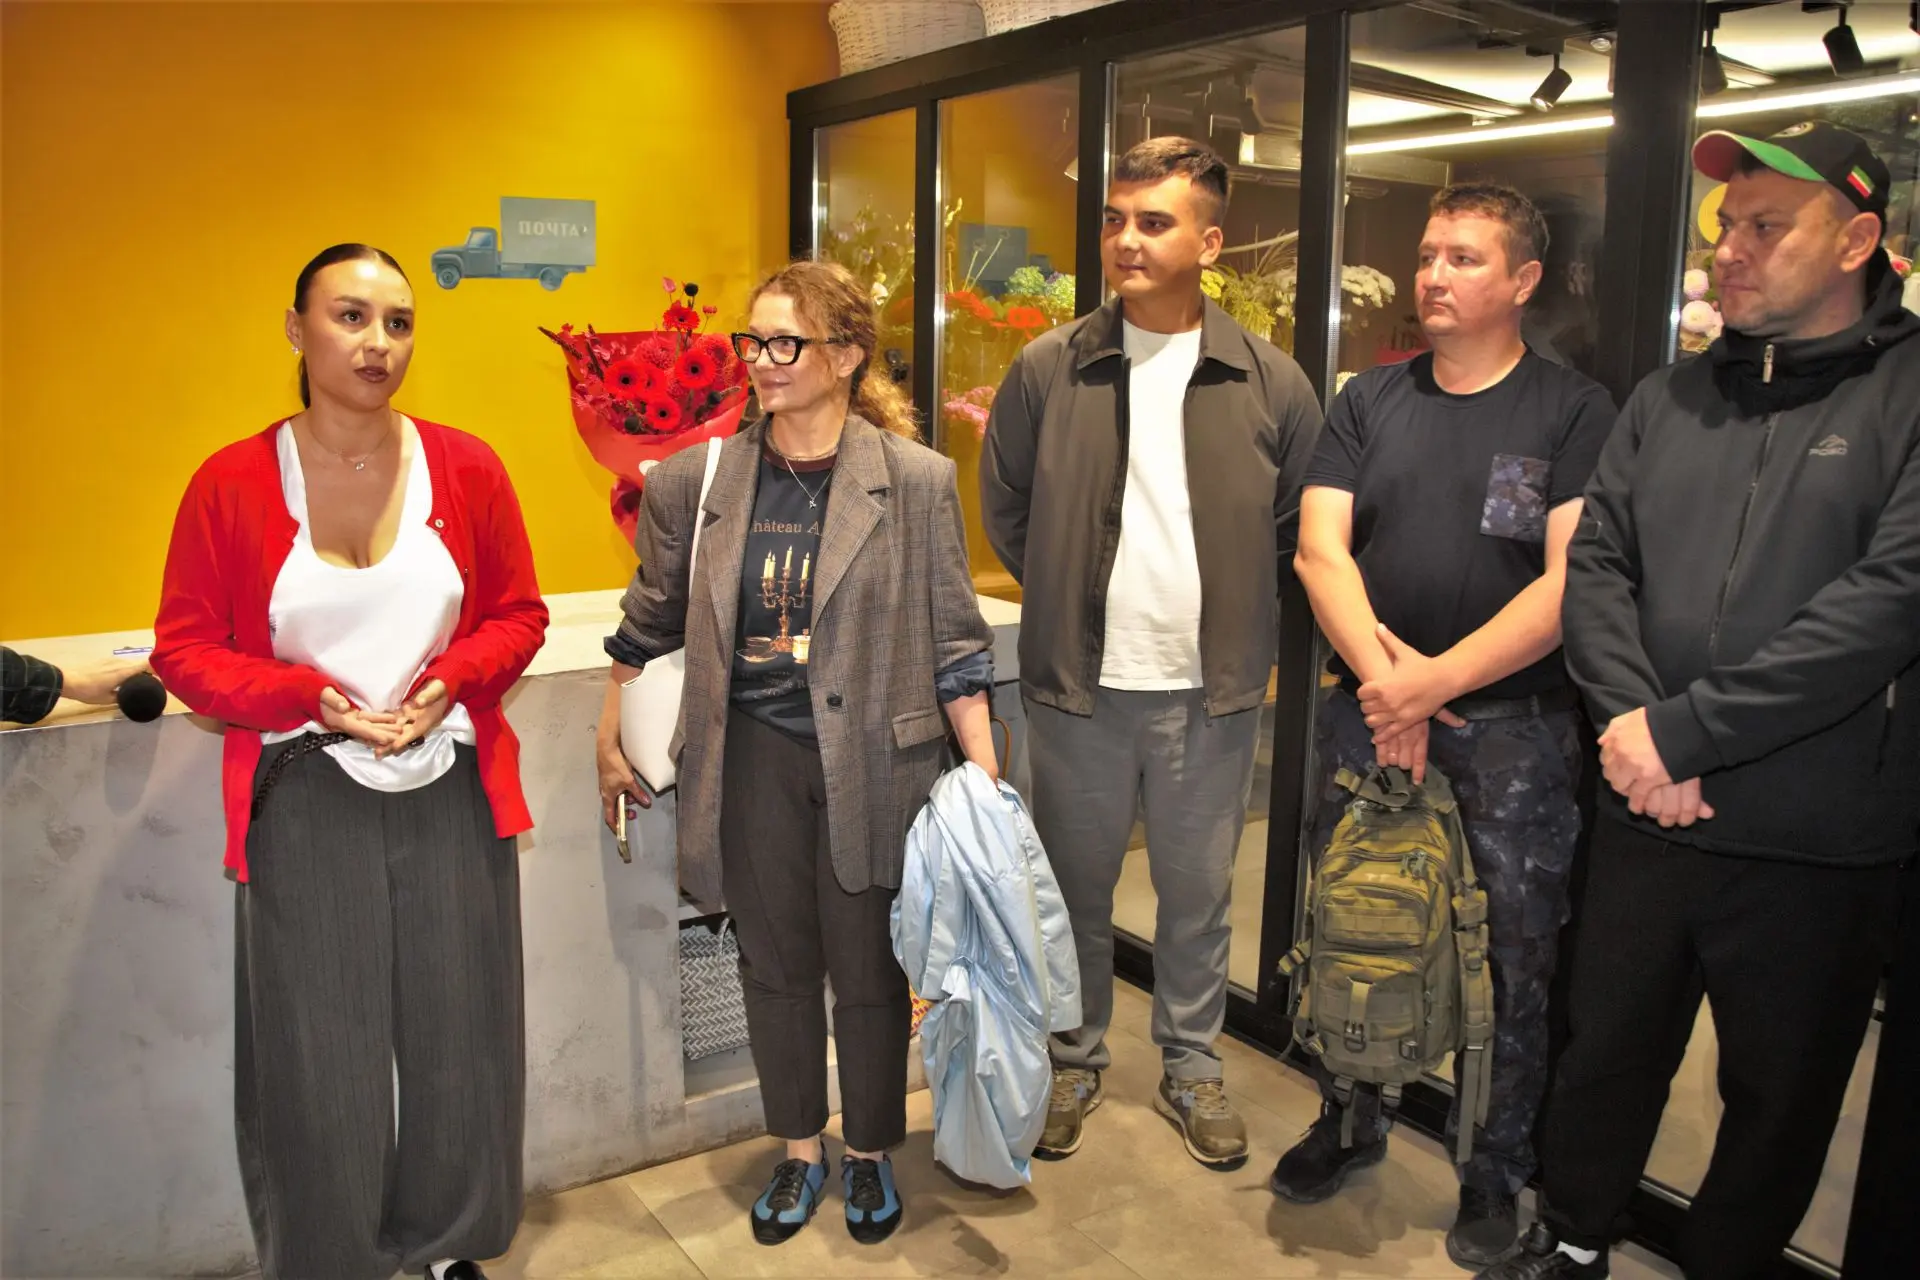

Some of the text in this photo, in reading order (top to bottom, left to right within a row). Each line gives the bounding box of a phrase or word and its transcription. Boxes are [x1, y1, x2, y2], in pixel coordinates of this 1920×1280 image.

[519, 221, 580, 237] ПОЧТА
[752, 518, 821, 536] hâteau A
